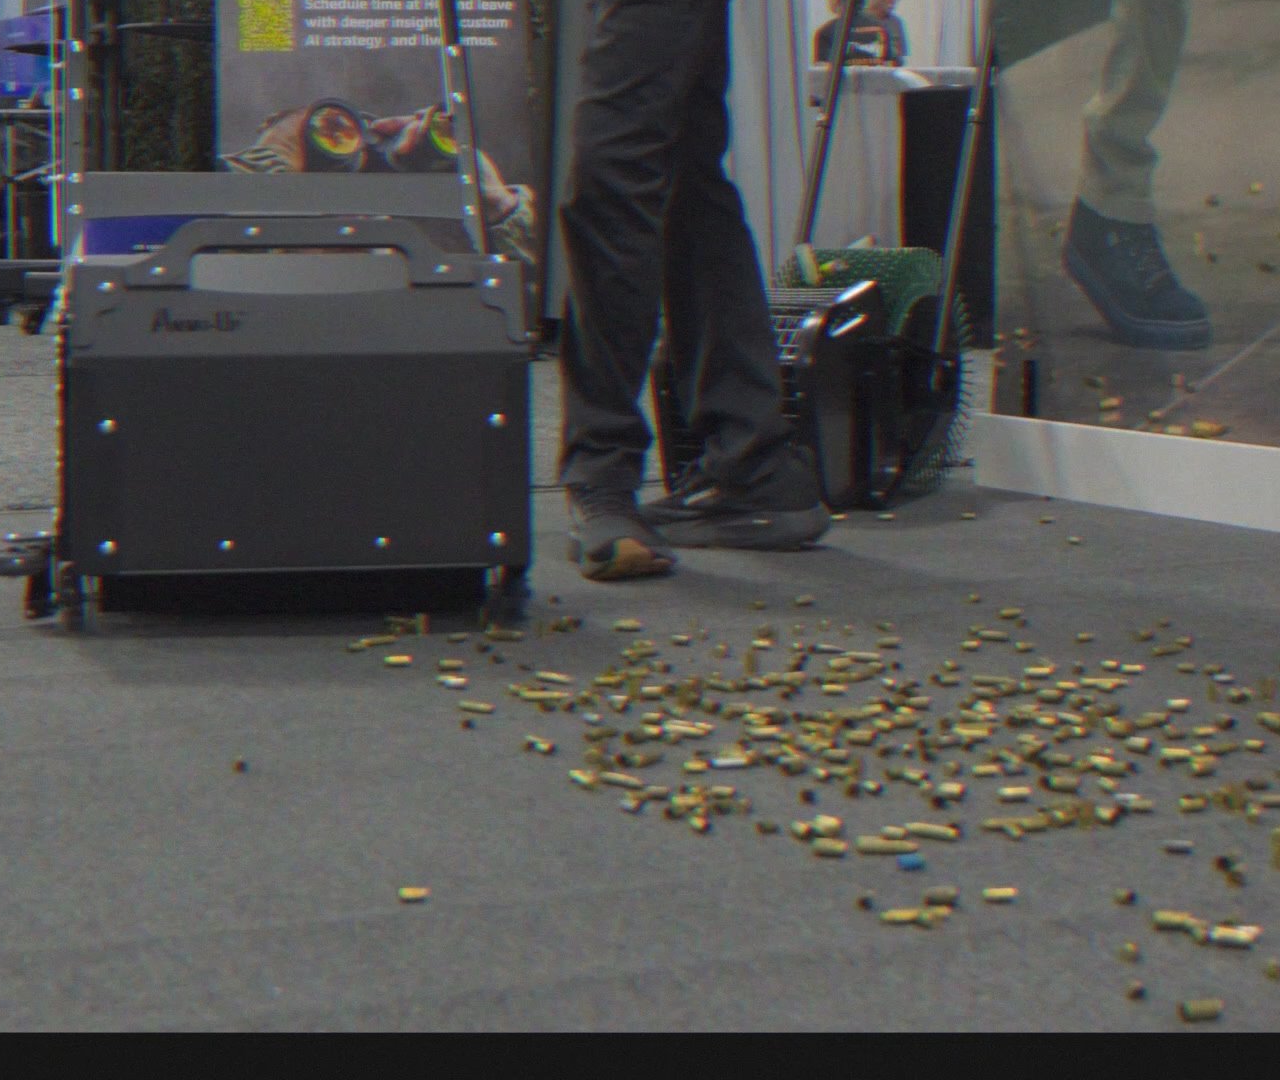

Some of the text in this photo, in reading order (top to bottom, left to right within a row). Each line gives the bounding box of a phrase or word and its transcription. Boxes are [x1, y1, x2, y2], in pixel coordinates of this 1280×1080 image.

[371, 0, 404, 11] time
[404, 0, 422, 11] at
[476, 0, 515, 12] leave
[304, 16, 337, 29] with
[340, 17, 389, 32] deeper
[304, 35, 322, 47] AI
[389, 35, 418, 48] and
[420, 35, 442, 48] liv
